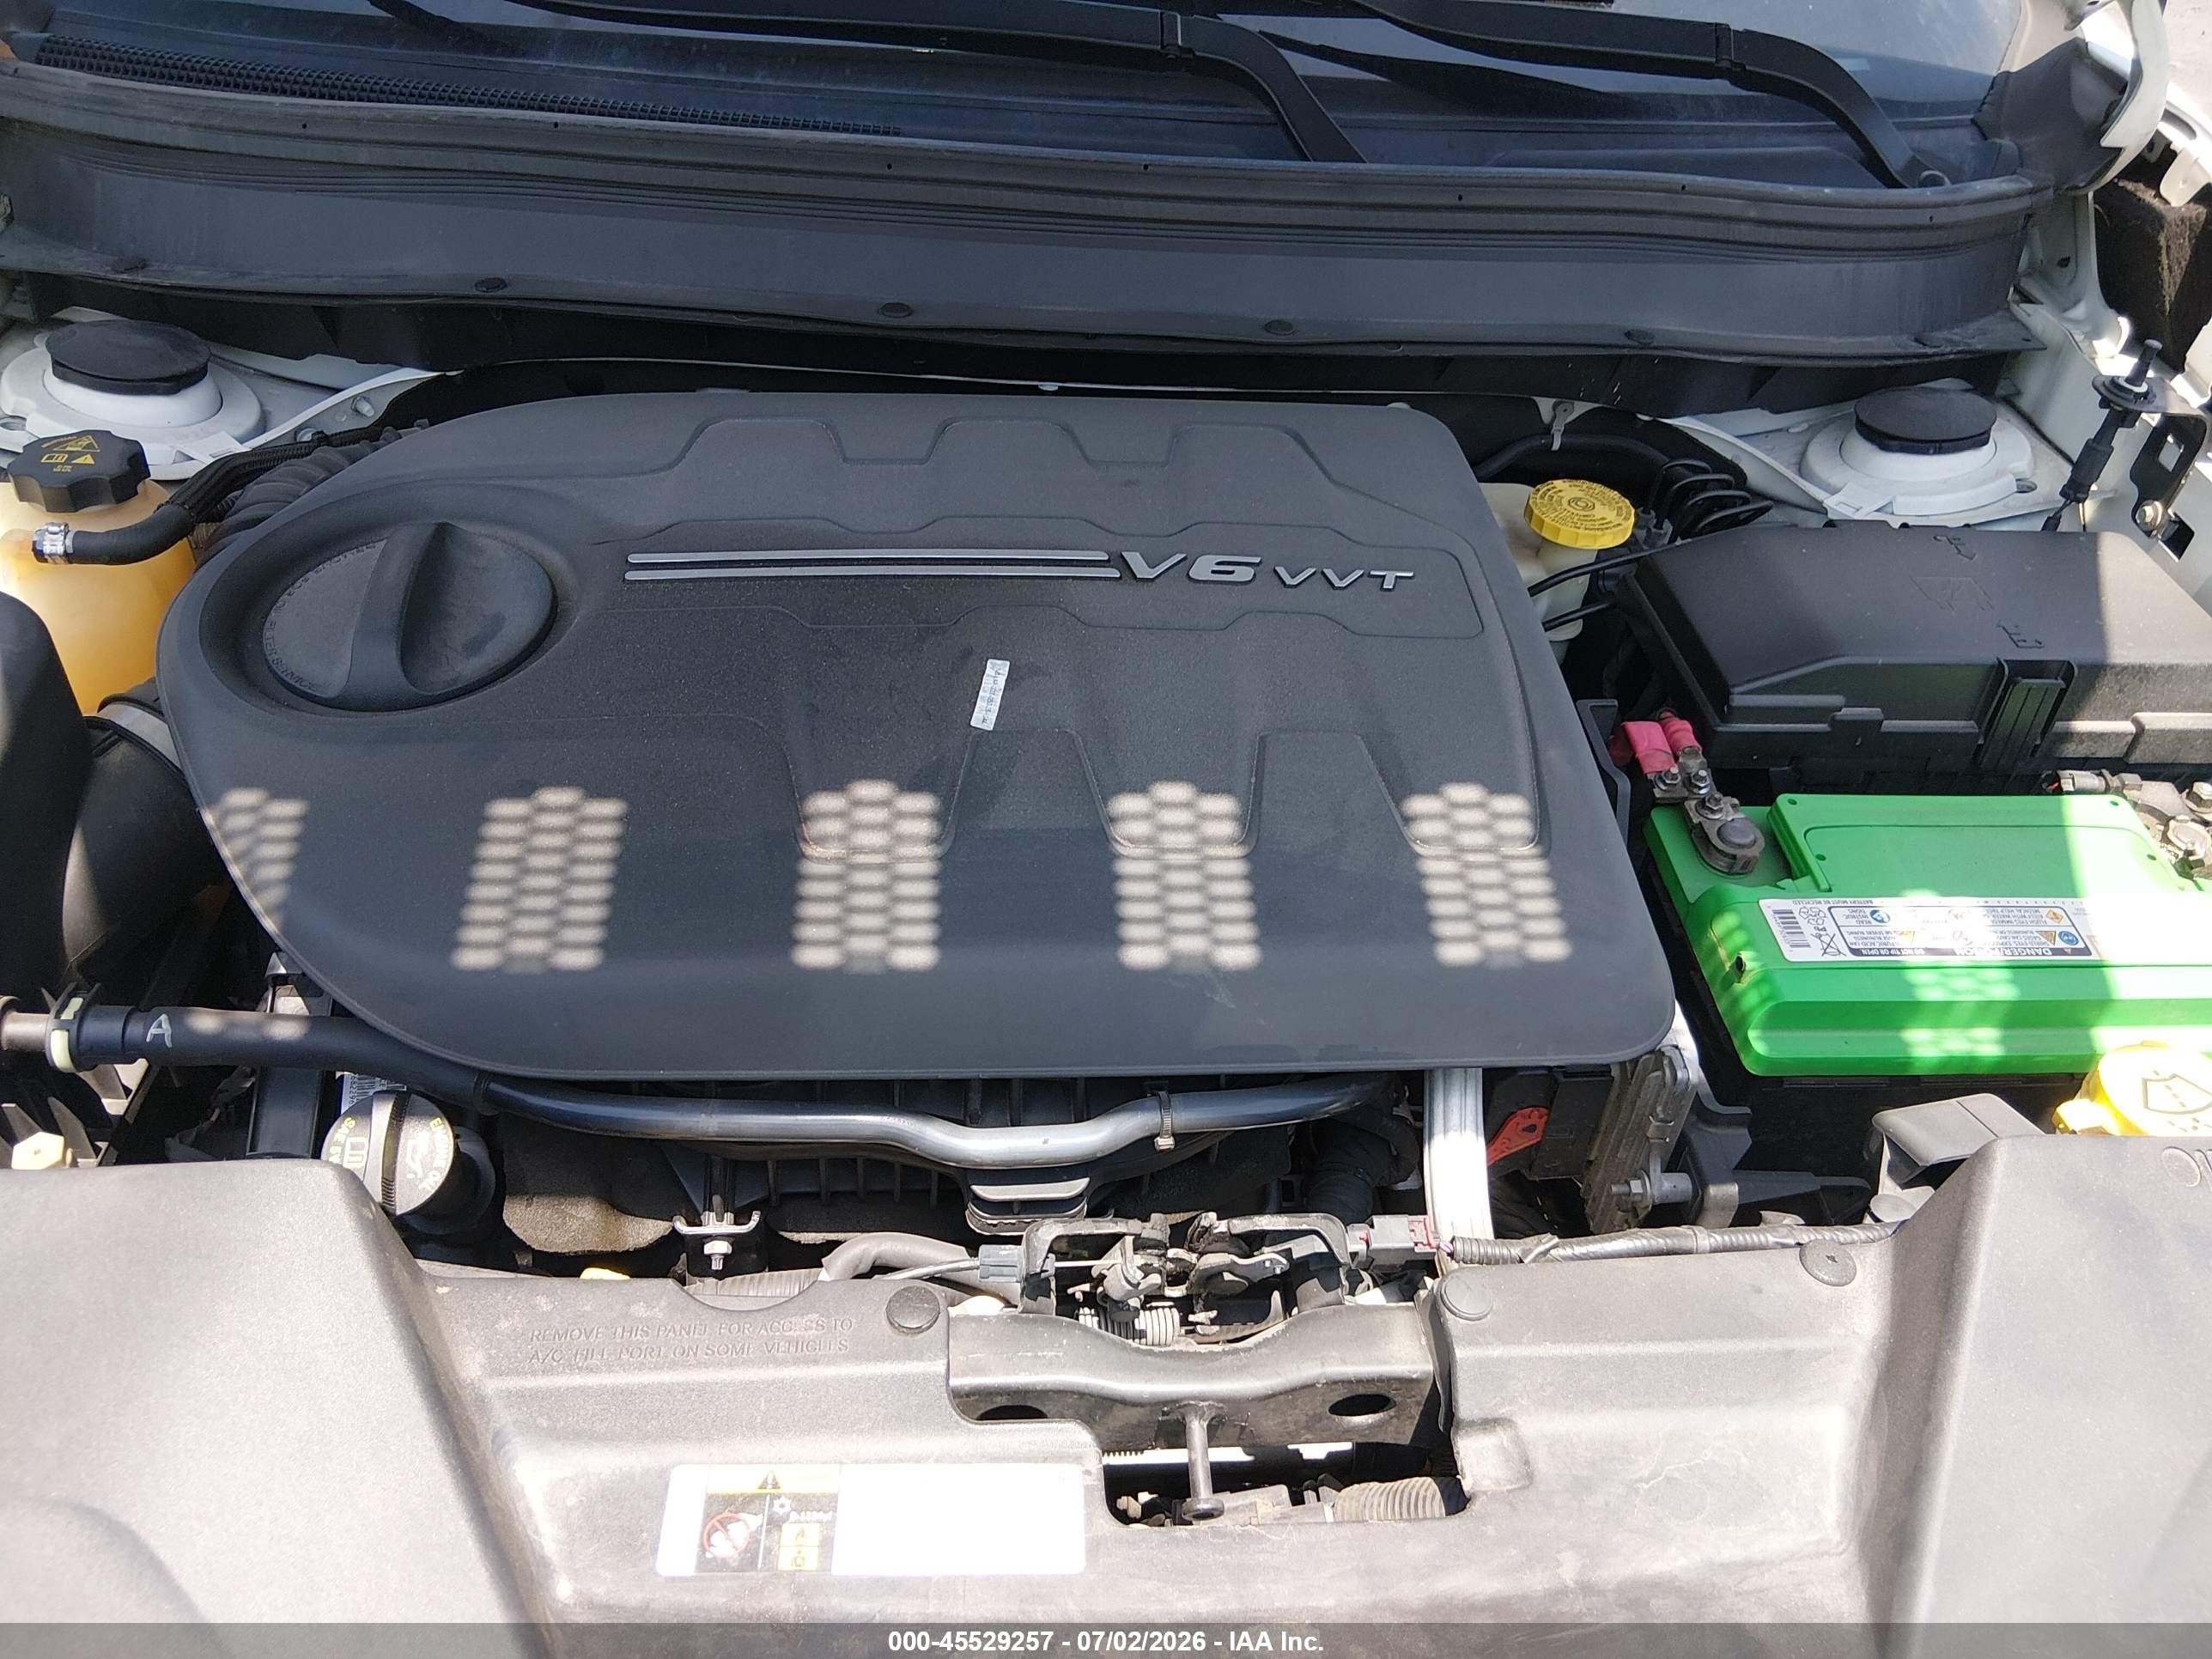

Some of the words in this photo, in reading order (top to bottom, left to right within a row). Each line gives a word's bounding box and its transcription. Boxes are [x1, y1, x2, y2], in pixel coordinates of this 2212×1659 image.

[1121, 551, 1261, 582] V6
[1273, 567, 1414, 590] VVT
[146, 1013, 173, 1048] A
[333, 1117, 356, 1144] SAE
[418, 1169, 441, 1193] OIL
[530, 1326, 605, 1341] REMOVE
[611, 1325, 650, 1340] THIS
[657, 1323, 708, 1339] PANEL
[718, 1322, 752, 1335] FOR
[833, 1318, 853, 1331] TO
[529, 1347, 563, 1364] A/C
[574, 1346, 610, 1362] FILL
[618, 1346, 663, 1360] PORT
[673, 1343, 699, 1359] ON
[705, 1342, 752, 1357] SOME
